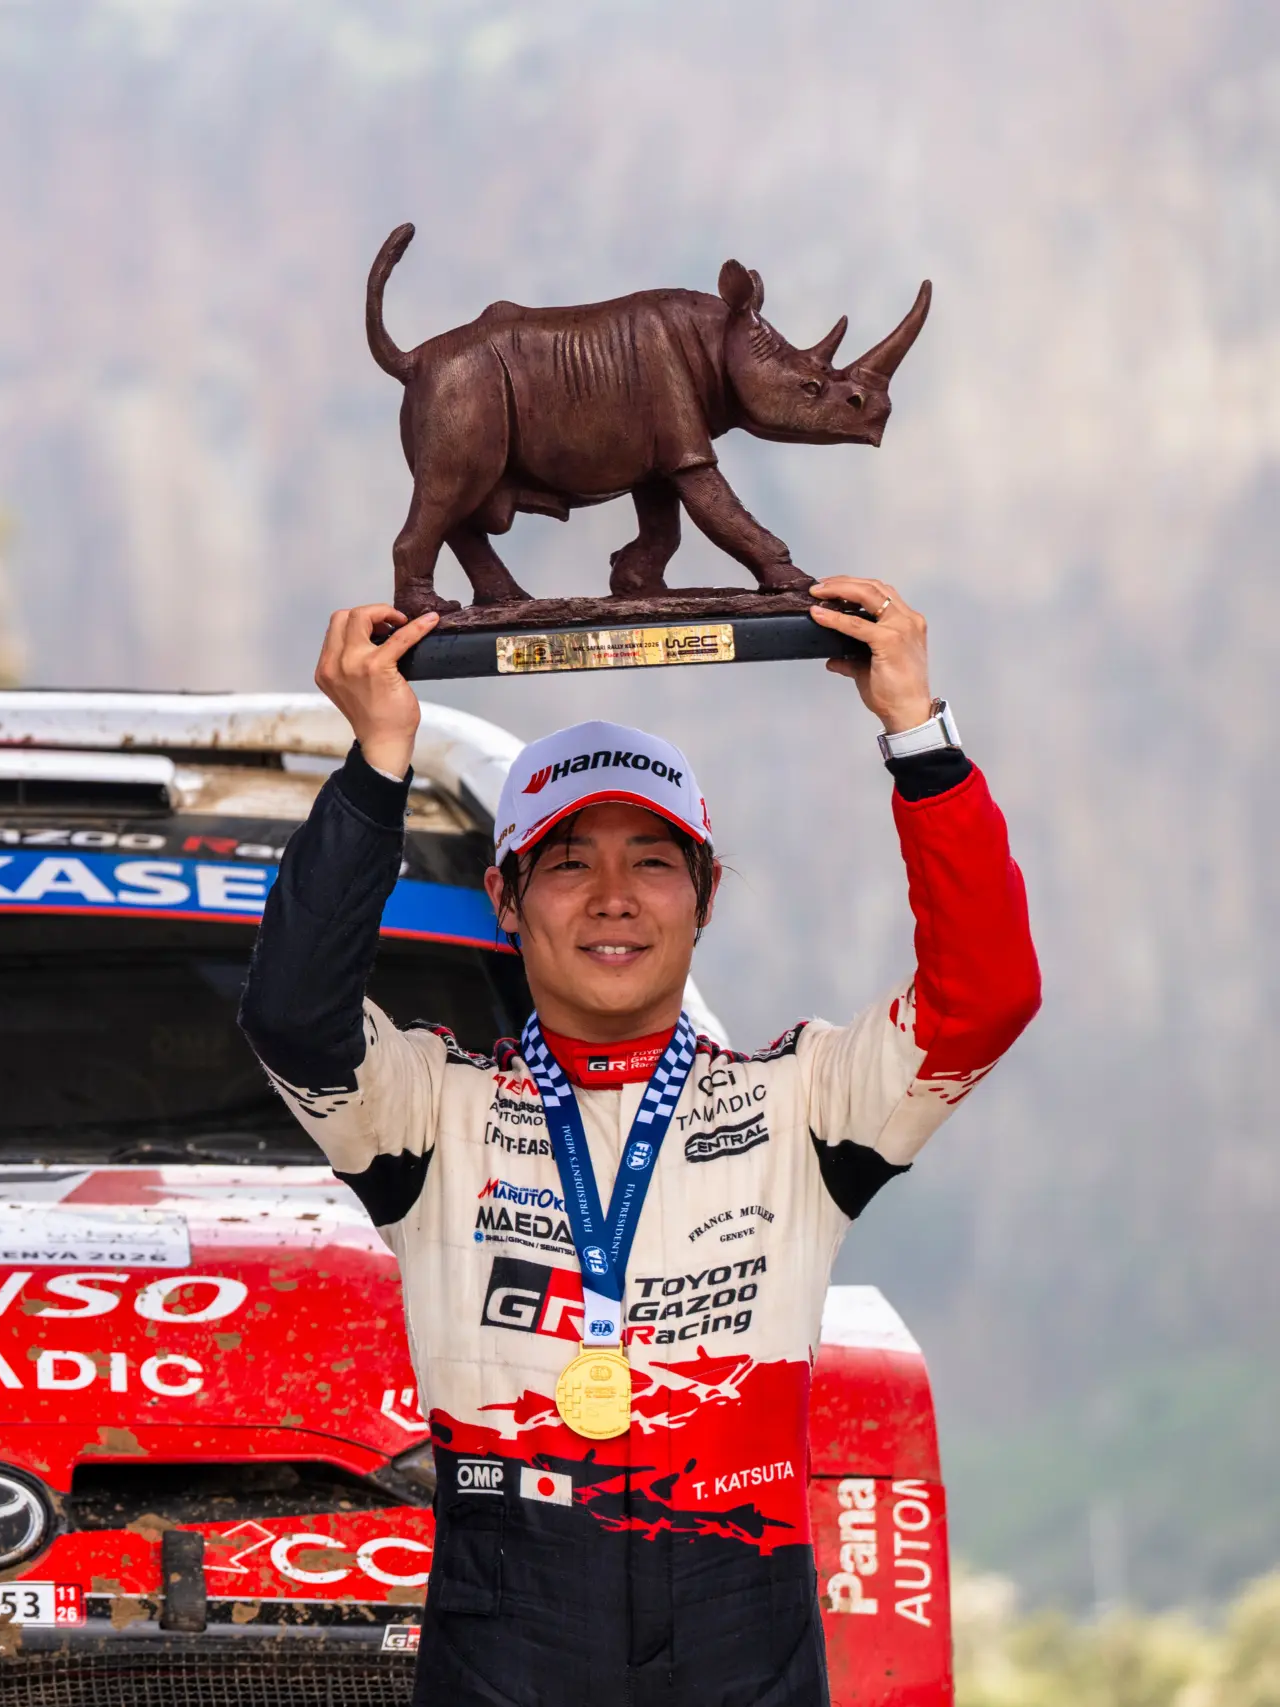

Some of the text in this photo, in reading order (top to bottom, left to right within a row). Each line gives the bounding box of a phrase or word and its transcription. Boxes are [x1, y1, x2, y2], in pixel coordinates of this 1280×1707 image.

[665, 635, 717, 648] WRC
[588, 1061, 627, 1071] GR
[675, 1084, 767, 1131] TAMADIC
[561, 1123, 576, 1156] MEDAL
[684, 1124, 768, 1156] CENTRAL
[623, 1183, 635, 1198] FIA
[475, 1205, 575, 1246] MAEDA
[584, 1217, 593, 1233] FIA
[688, 1210, 734, 1243] FRANCK
[719, 1227, 755, 1243] GENEVE
[89, 1250, 169, 1262] 2026
[634, 1255, 767, 1298] TOYOTA
[487, 1286, 585, 1340] GR
[628, 1283, 758, 1322] GAZOO
[626, 1309, 753, 1346] Racing
[457, 1465, 504, 1489] OMP
[692, 1461, 795, 1501] T. KATSUTA
[825, 1478, 879, 1616] Pana
[56, 1587, 75, 1601] 11
[56, 1607, 77, 1622] 26
